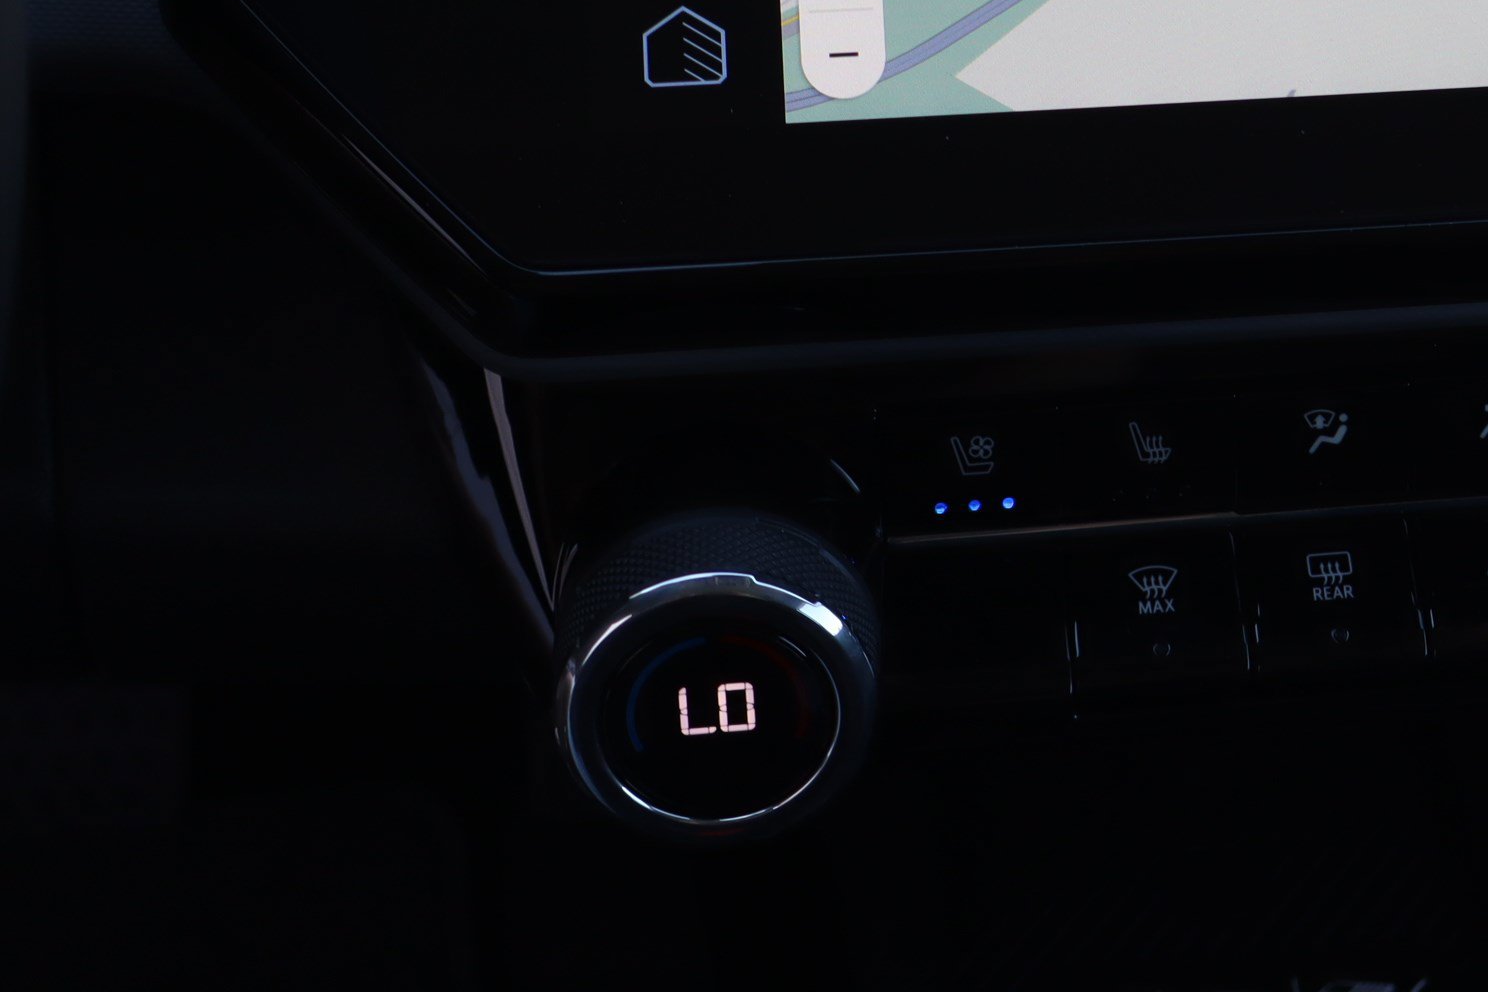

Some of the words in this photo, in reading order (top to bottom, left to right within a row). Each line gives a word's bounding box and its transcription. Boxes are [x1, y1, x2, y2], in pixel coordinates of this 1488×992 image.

[1312, 583, 1355, 601] REAR
[1138, 597, 1176, 614] MAX
[677, 681, 757, 736] LO
